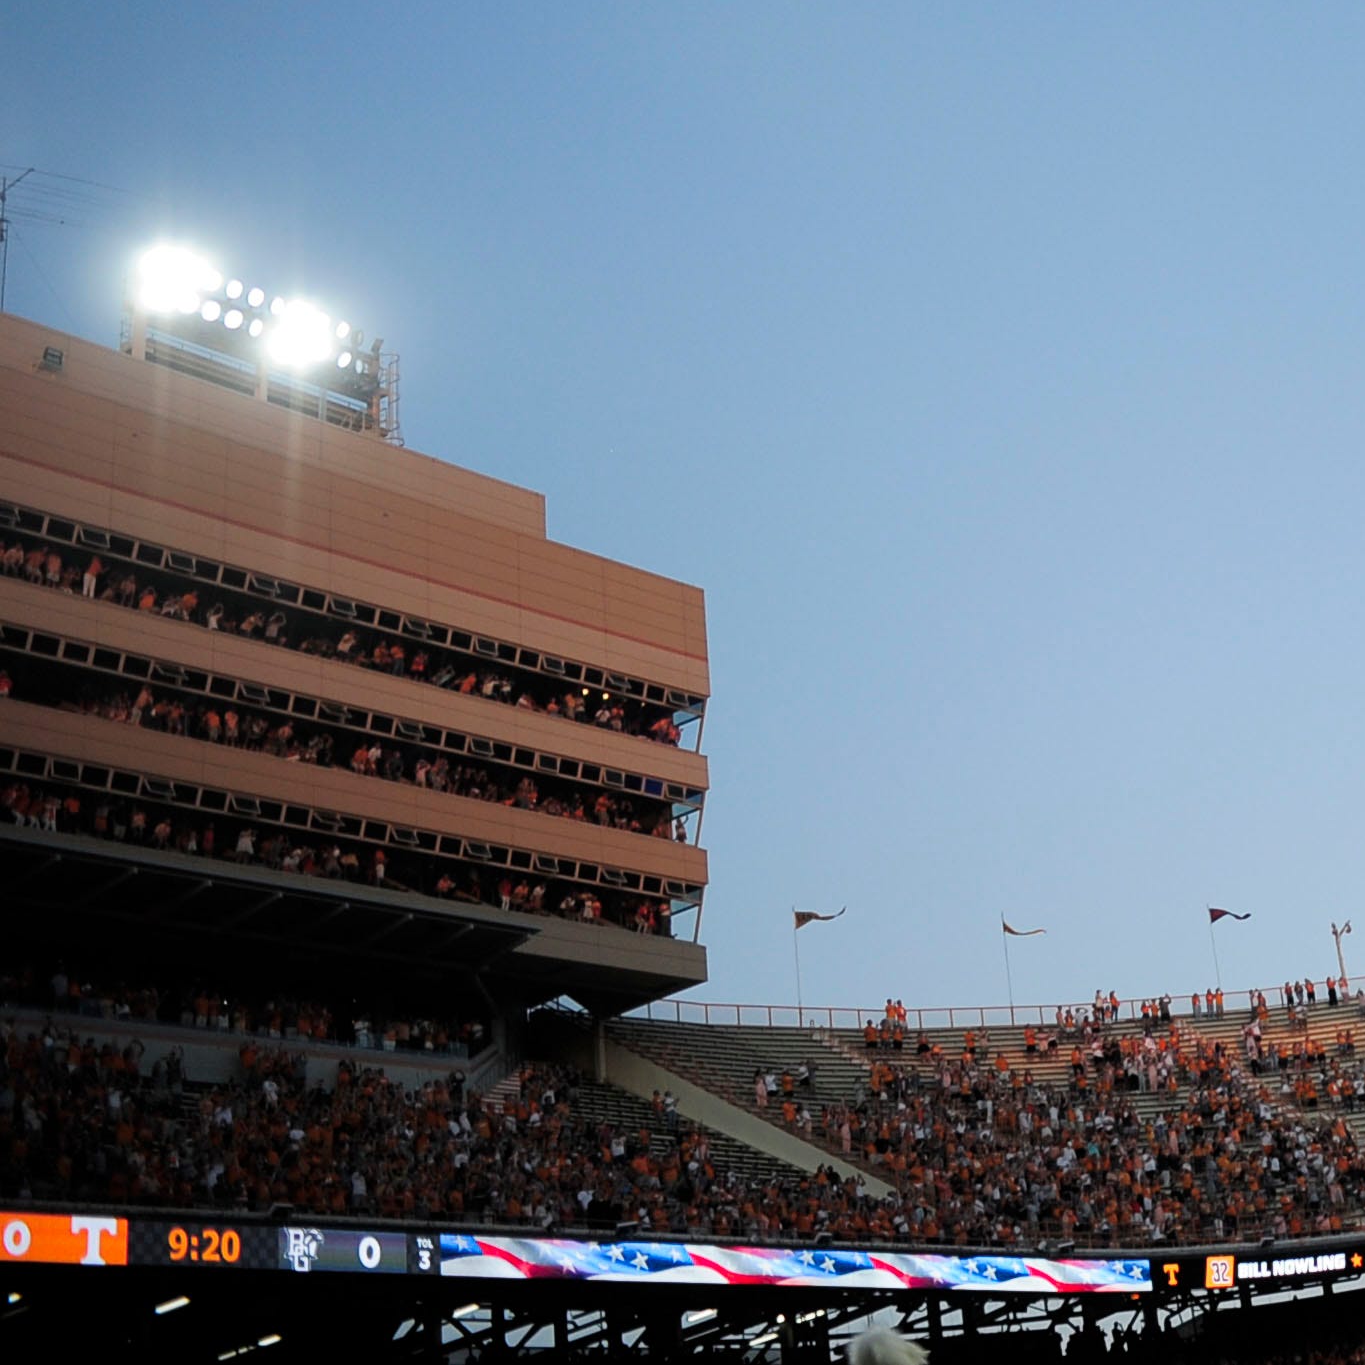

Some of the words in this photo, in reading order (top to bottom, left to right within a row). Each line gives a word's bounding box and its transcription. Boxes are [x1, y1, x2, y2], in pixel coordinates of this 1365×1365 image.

[3, 1220, 31, 1256] 0
[71, 1216, 118, 1266] T
[168, 1227, 241, 1263] 9:20
[358, 1236, 381, 1269] 0
[418, 1250, 432, 1270] 3
[1163, 1263, 1179, 1286] T
[1211, 1260, 1229, 1284] 32
[1237, 1261, 1272, 1279] BILL
[1272, 1253, 1346, 1276] NOWLING
